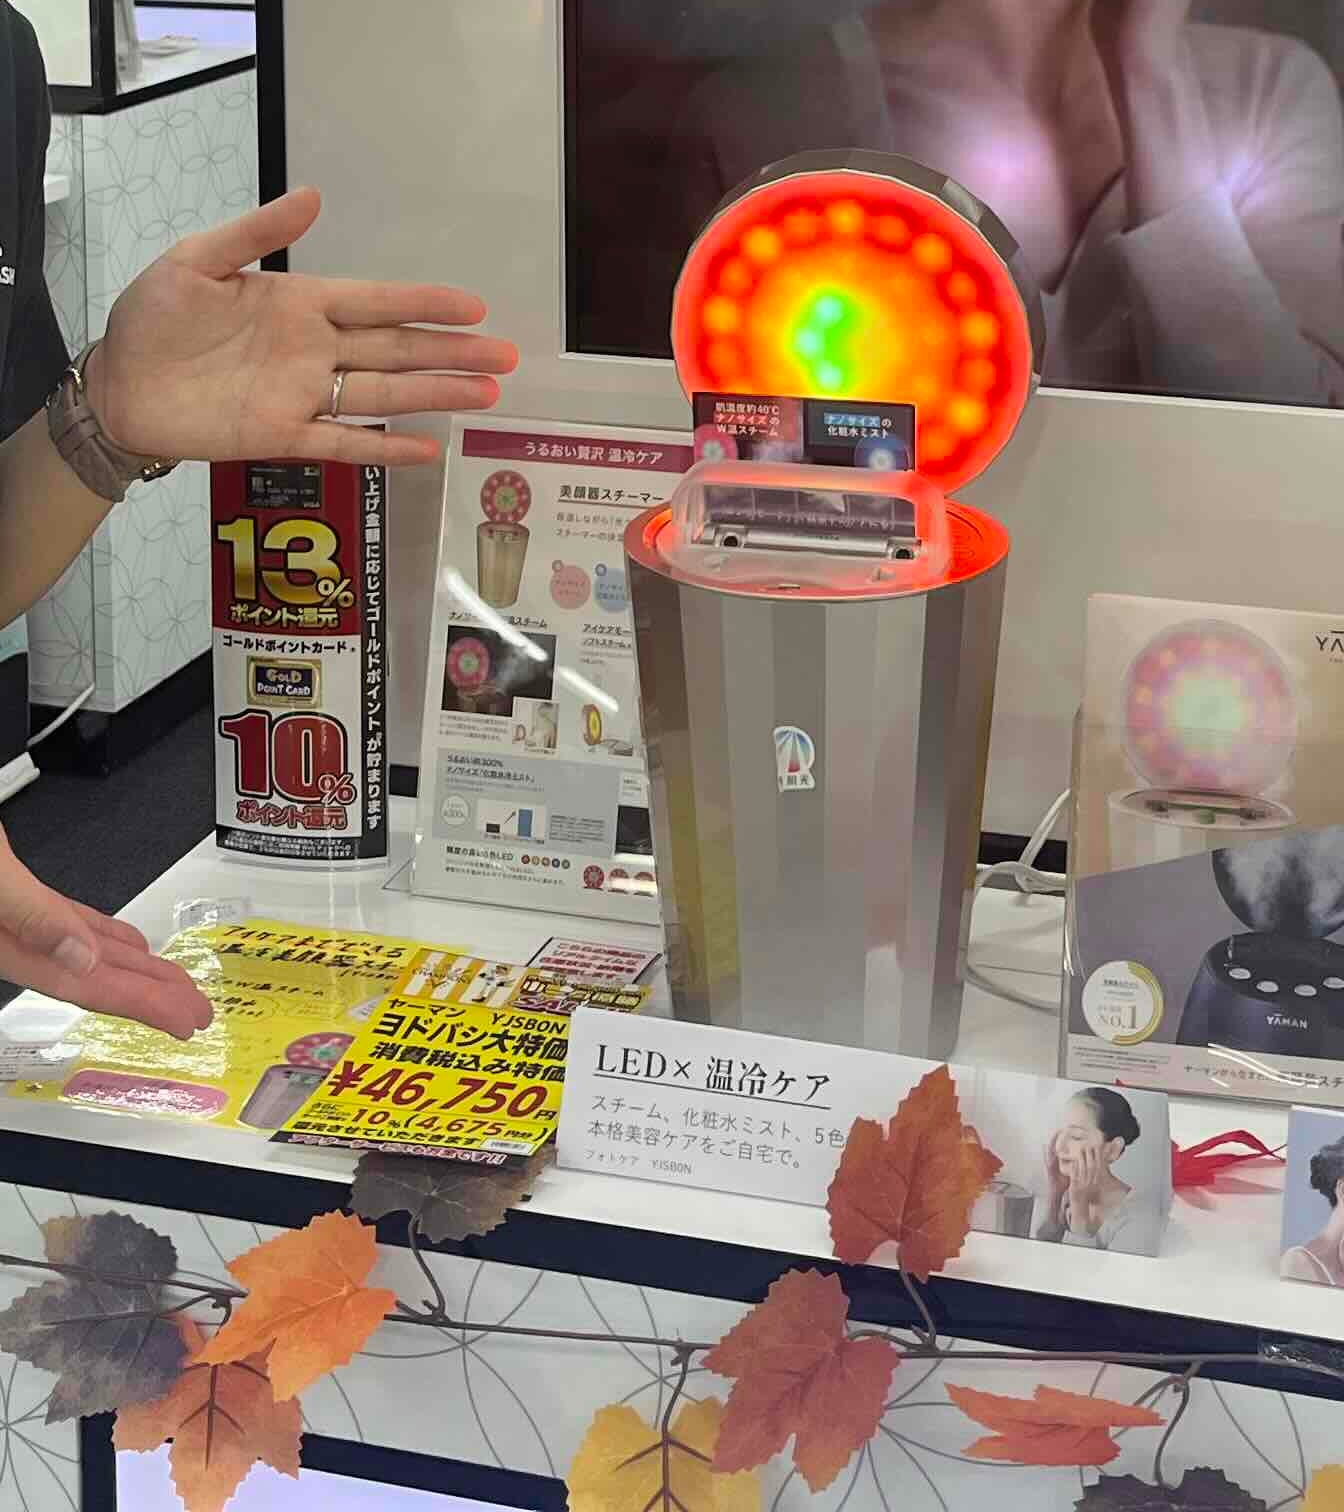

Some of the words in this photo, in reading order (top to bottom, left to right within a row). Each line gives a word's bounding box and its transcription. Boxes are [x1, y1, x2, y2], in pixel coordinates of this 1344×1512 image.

[215, 516, 355, 610] 13%
[230, 604, 340, 630] ポイント還元
[218, 708, 358, 806] 10%
[236, 799, 348, 832] ポイント還元
[387, 998, 466, 1019] ヤーマン
[373, 1012, 568, 1062] ヨドバシ大特価
[368, 1041, 567, 1082] 消費税込み特価
[705, 1054, 832, 1102] 温冷ケア
[588, 1119, 802, 1170] 本格美容ケアをご自宅で。
